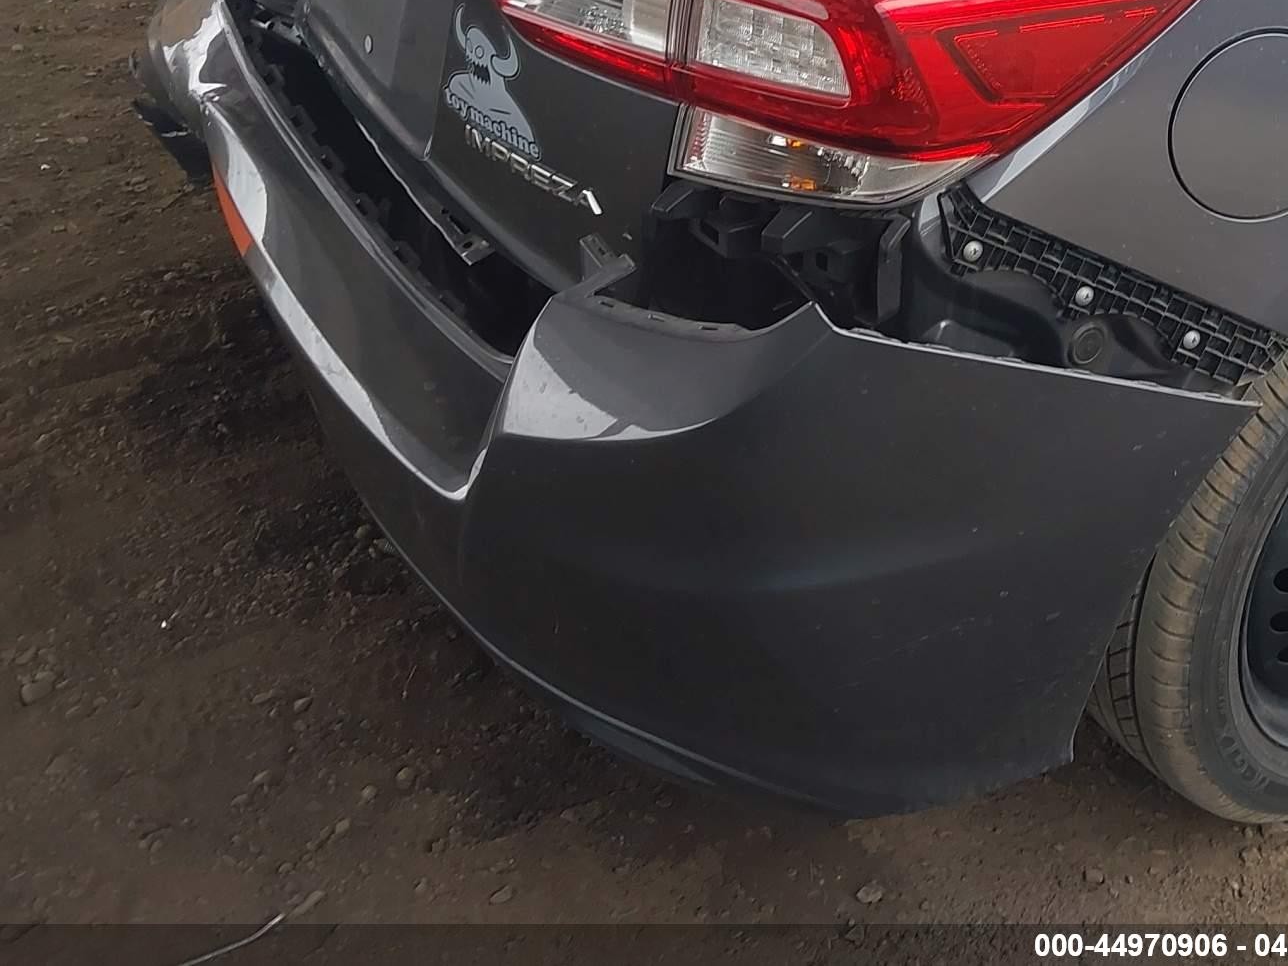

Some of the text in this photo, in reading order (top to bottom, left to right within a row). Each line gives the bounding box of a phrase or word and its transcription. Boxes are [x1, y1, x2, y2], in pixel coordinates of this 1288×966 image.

[445, 88, 541, 160] toy machine
[465, 124, 603, 215] IMPREZA
